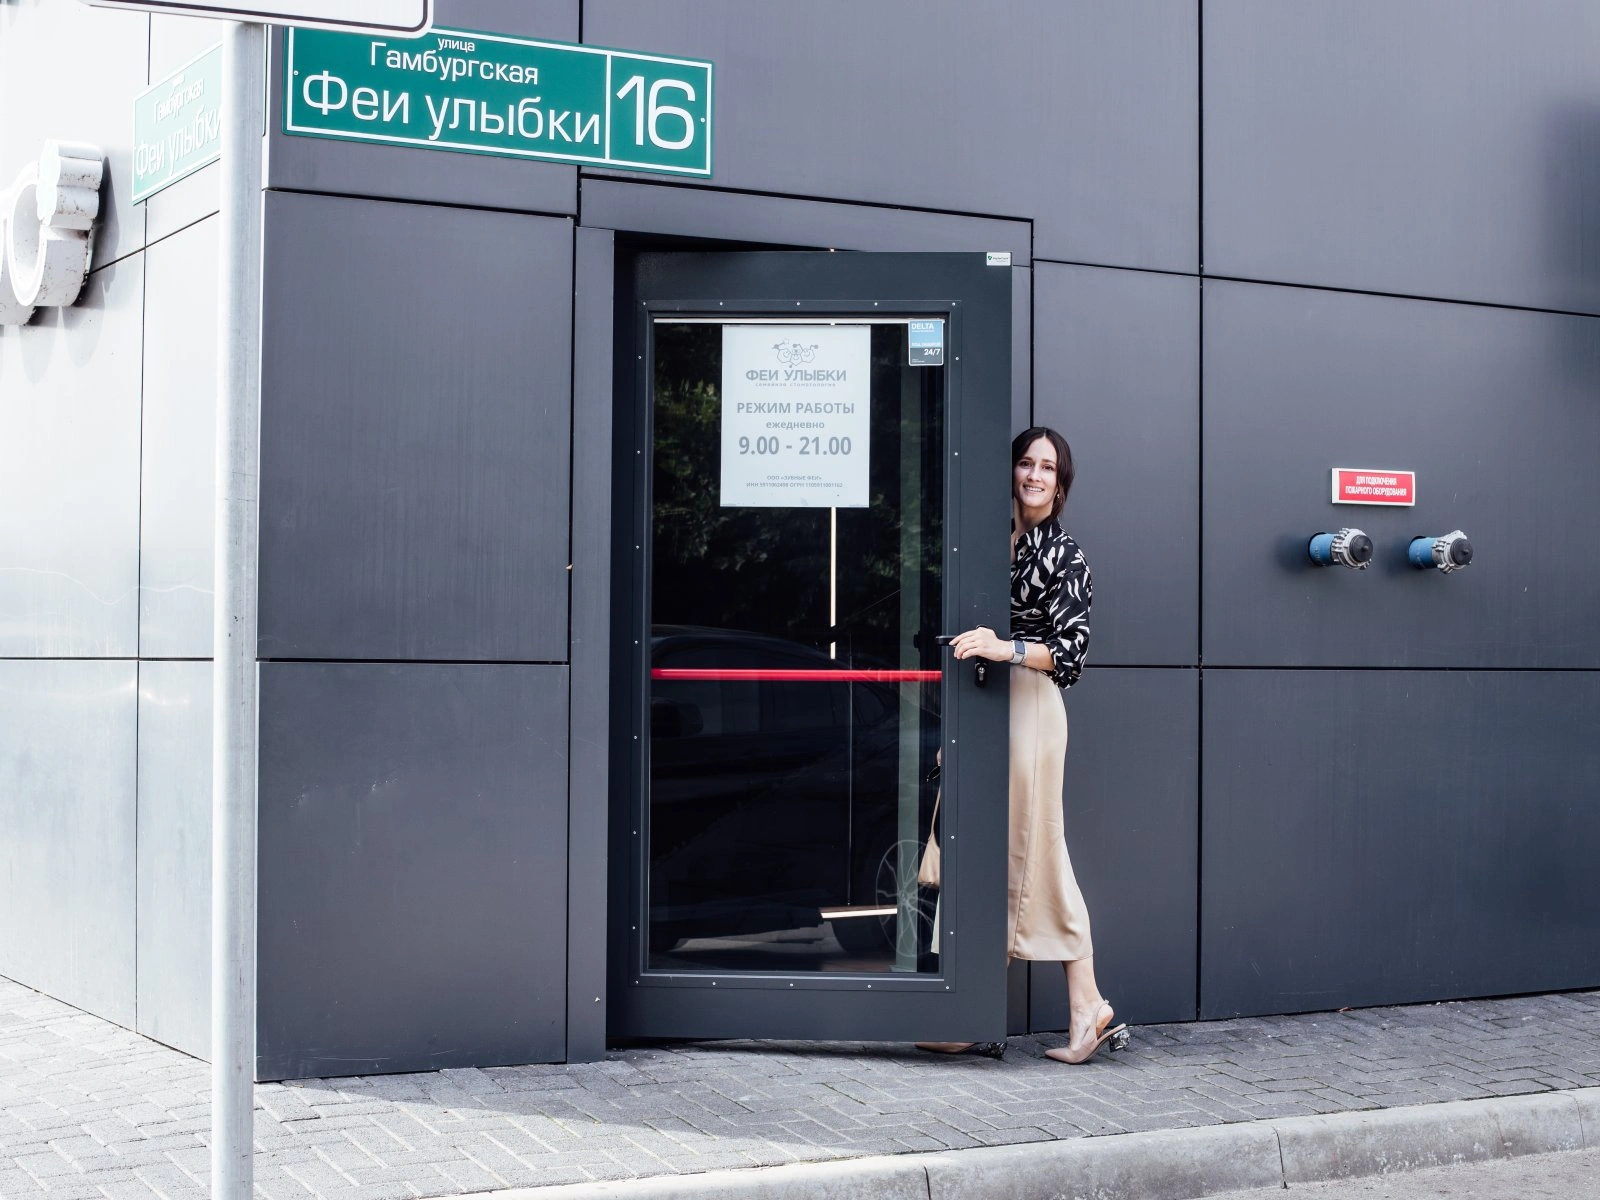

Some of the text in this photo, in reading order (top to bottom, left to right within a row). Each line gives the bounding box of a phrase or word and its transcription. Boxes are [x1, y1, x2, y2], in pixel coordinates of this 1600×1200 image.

[438, 37, 475, 52] улица
[370, 41, 539, 85] Гамбургская
[153, 78, 205, 124] Гамбургская
[302, 70, 600, 144] Феи улыбки
[615, 75, 696, 150] 16
[135, 140, 165, 180] Феи
[911, 322, 934, 330] DELTA
[924, 348, 940, 356] 24/7
[746, 369, 847, 381] ФЕИ УЛЫБКИ
[737, 402, 855, 414] РЕЖИМ РАБОТЫ
[766, 421, 825, 430] ежедневно
[739, 436, 780, 455] 9.00
[799, 436, 852, 455] 21.00
[1356, 476, 1365, 485] ДЛЯ
[1345, 486, 1406, 496] ПОЖАРНОГО ОБОРУДОВАНИЯ
